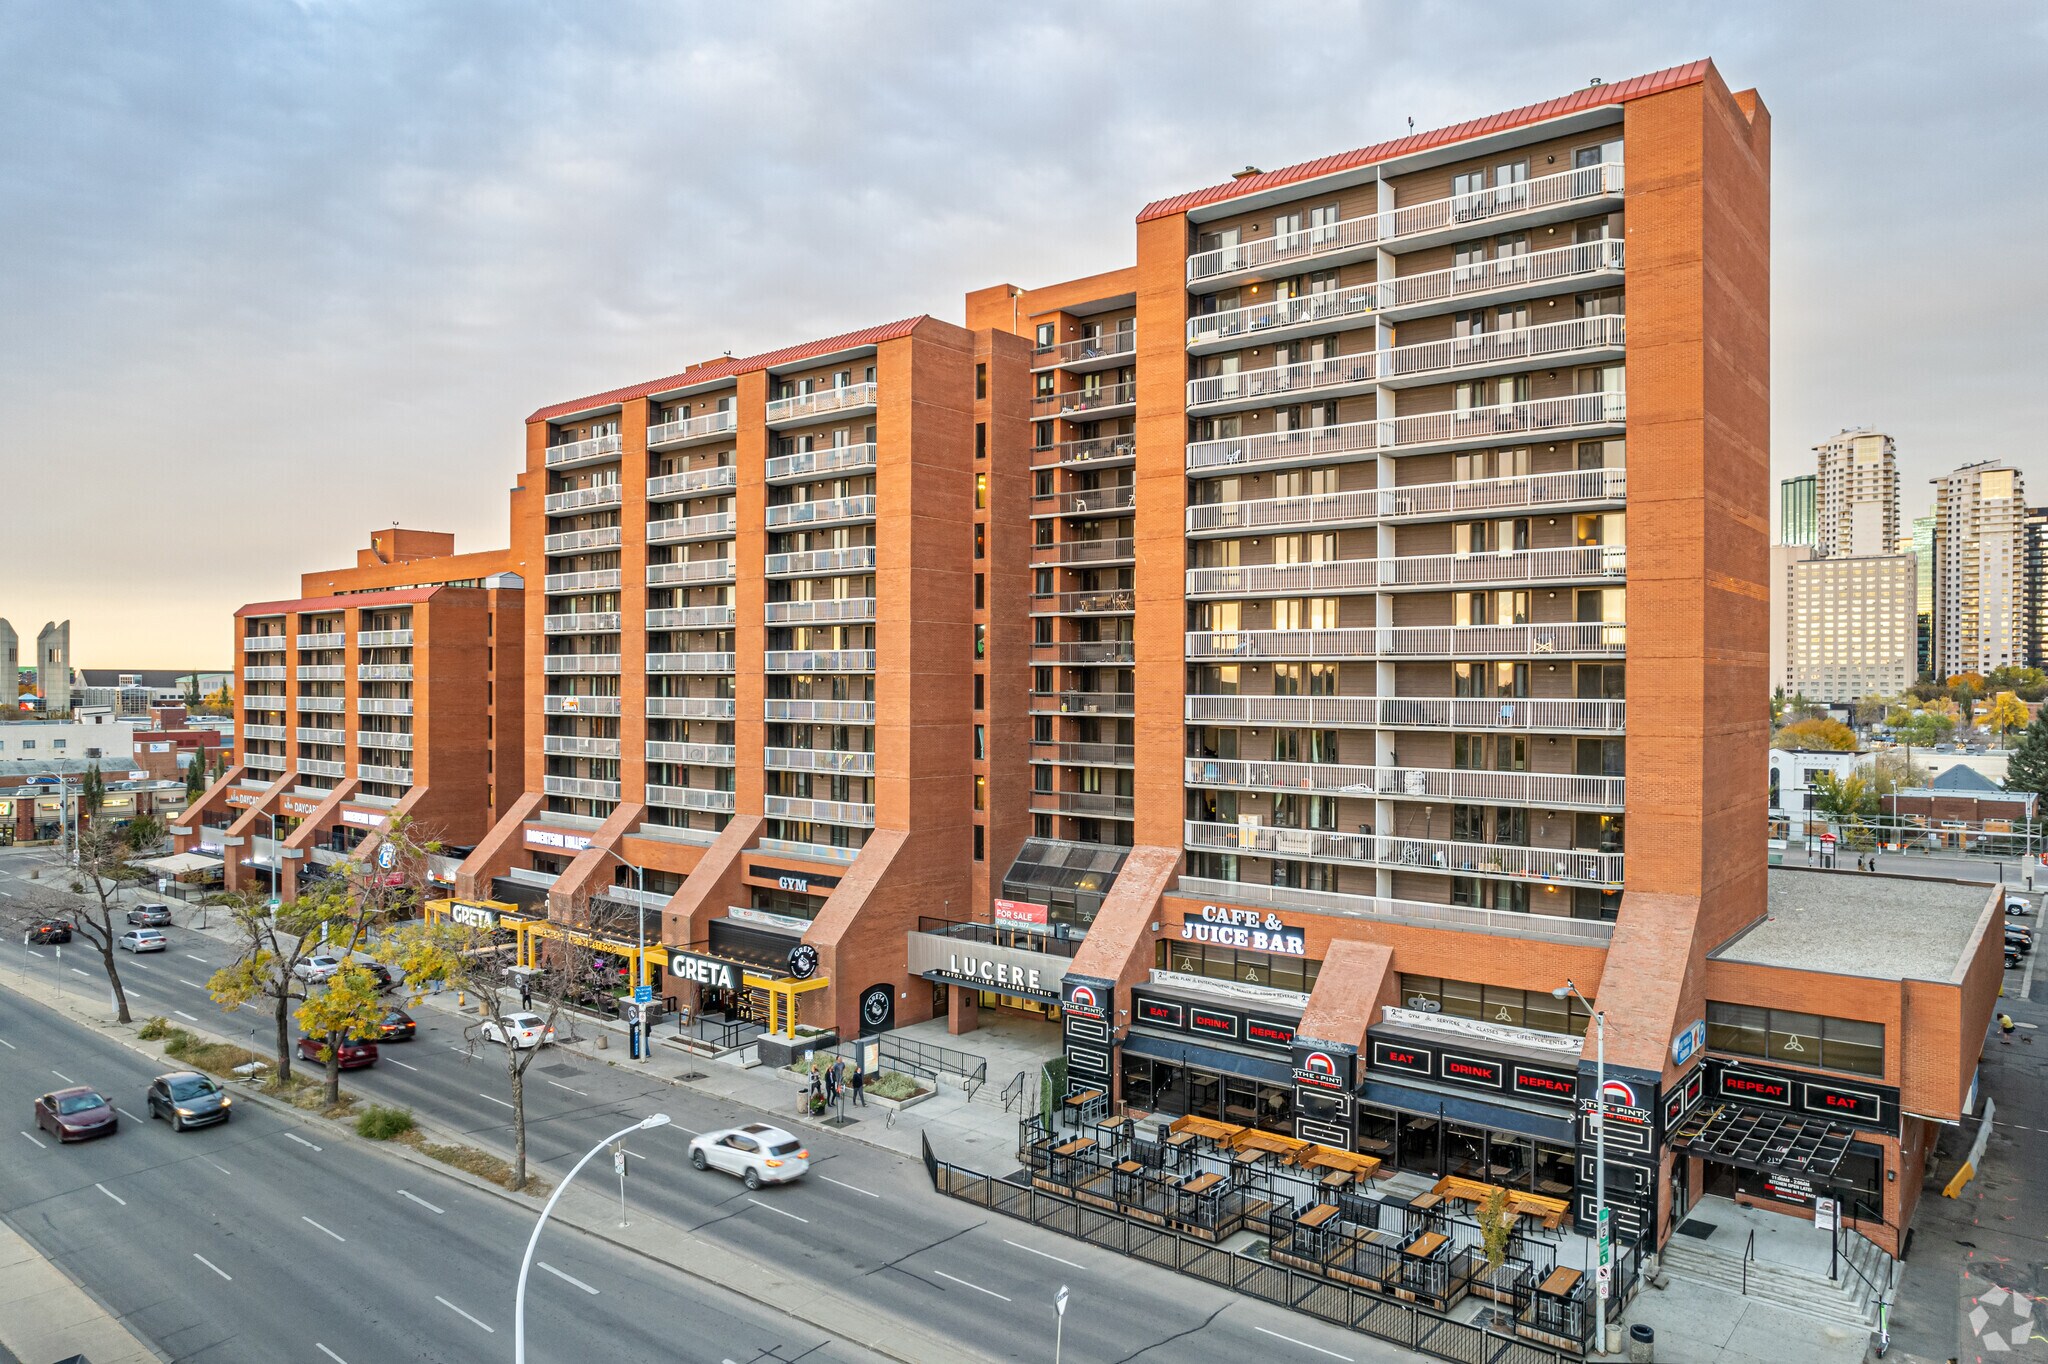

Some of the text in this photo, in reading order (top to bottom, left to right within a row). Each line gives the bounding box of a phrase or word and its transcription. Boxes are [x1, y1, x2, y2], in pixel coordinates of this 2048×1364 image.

[779, 877, 807, 892] GYM
[452, 904, 492, 928] GRETA
[996, 909, 1033, 921] FOR SALE
[1202, 905, 1282, 931] CAFE &
[1181, 923, 1304, 955] JUICE BAR
[794, 946, 814, 957] GRETA
[672, 955, 734, 988] GRETA
[950, 954, 1041, 988] LUCERE
[942, 971, 1052, 997] BOTOX FILLER LASER CLINIC
[868, 994, 885, 1005] GRETA
[1066, 1002, 1100, 1014] THE PINT
[1150, 1007, 1168, 1018] EAT
[1196, 1017, 1229, 1030] DRINK
[1436, 1017, 1460, 1026] SERVICES
[1476, 1026, 1499, 1035] CLASSES
[1250, 1027, 1292, 1041] REPEAT
[1389, 1052, 1415, 1064] EAT
[1297, 1071, 1341, 1084] THE PINT
[1450, 1063, 1493, 1078] DRINK
[1519, 1075, 1572, 1092] REPEAT
[1727, 1078, 1783, 1096] REPEAT
[1826, 1095, 1857, 1109] EAT
[1616, 1107, 1643, 1119] PINT
[1769, 1179, 1788, 1187] KITCHEN
